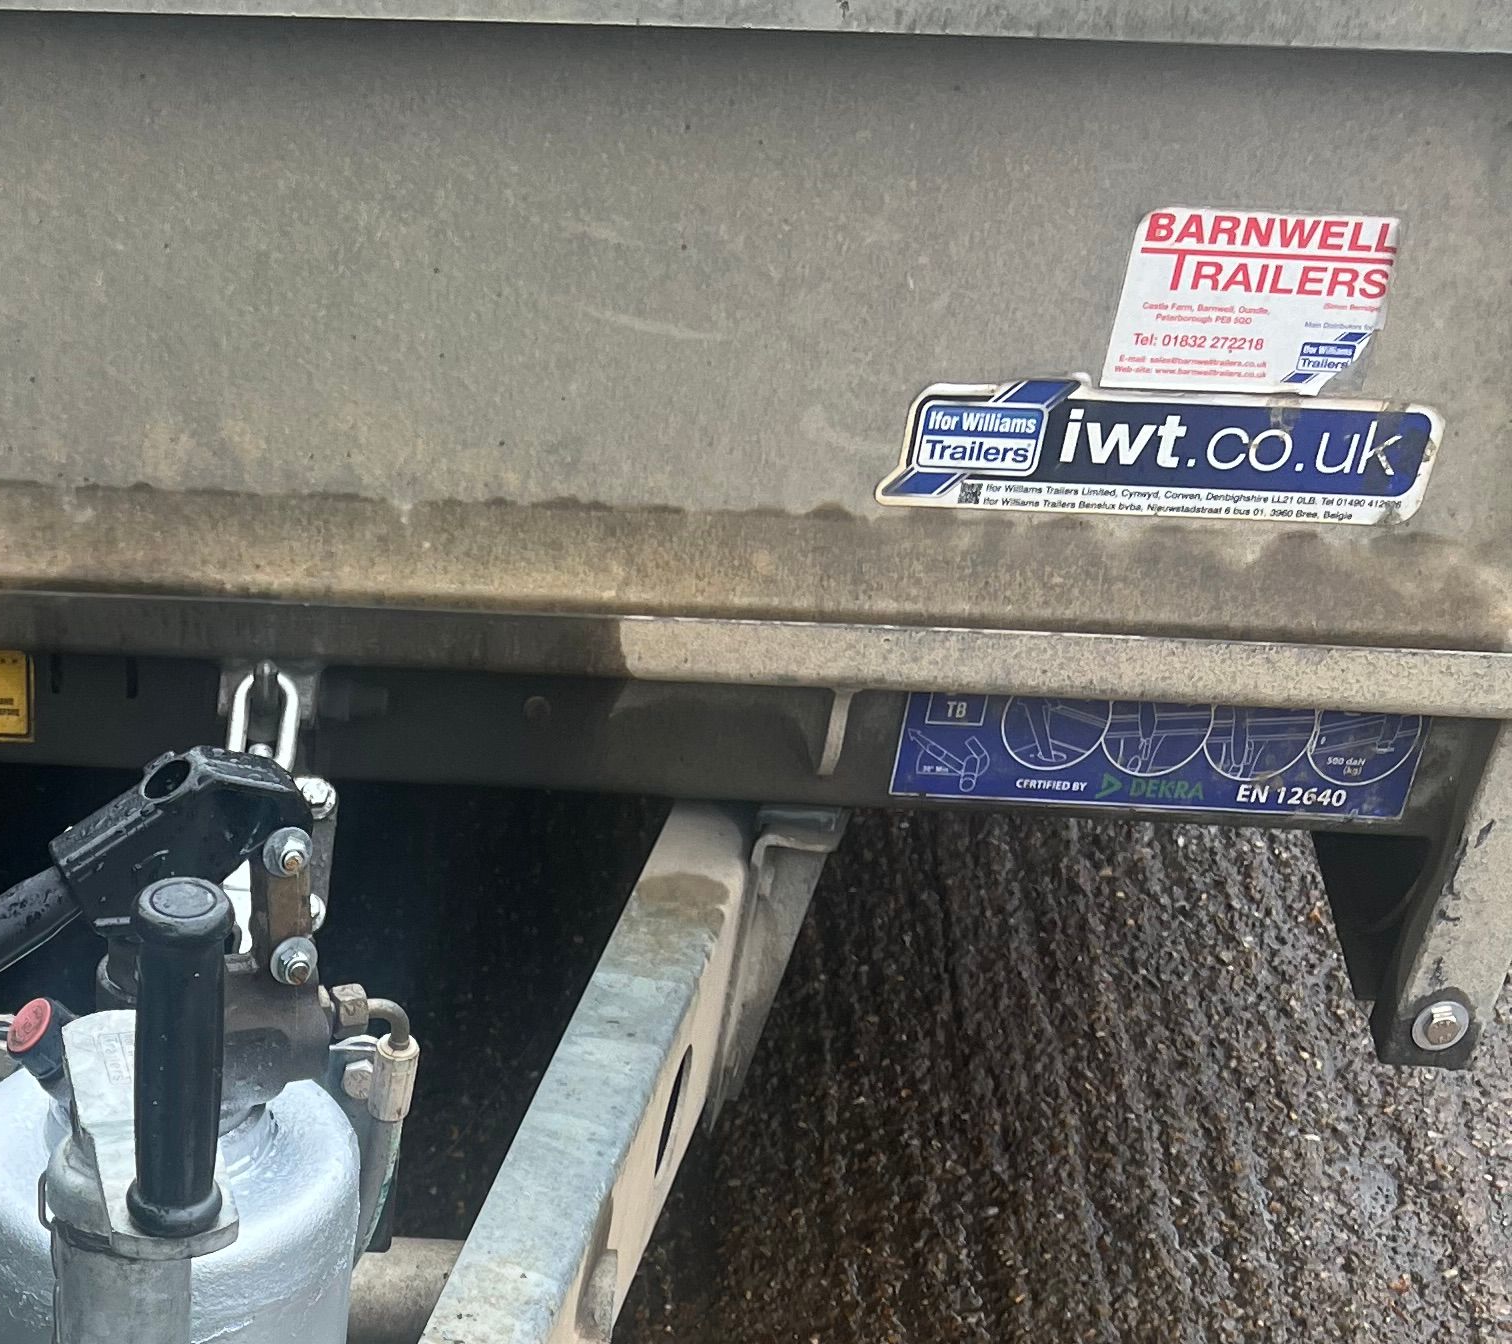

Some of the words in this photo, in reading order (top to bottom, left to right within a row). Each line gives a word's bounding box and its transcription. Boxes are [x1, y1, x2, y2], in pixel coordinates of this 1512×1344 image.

[1144, 212, 1397, 254] BARNWELL
[1170, 252, 1388, 299] TRAILERS
[1133, 333, 1158, 346] Tel:
[1162, 334, 1207, 348] 01832
[1210, 336, 1264, 350] 272218
[928, 411, 959, 431] Ifor
[962, 412, 1037, 434] Williams
[925, 439, 1029, 464] Trailers
[1059, 408, 1403, 476] iwt.co.uk
[1336, 499, 1365, 508] 01490
[1015, 778, 1071, 791] CERTIFIED
[1072, 782, 1088, 792] BY
[1129, 778, 1205, 801] DEKRA
[1236, 783, 1269, 804] EN
[1276, 786, 1347, 807] 12640
